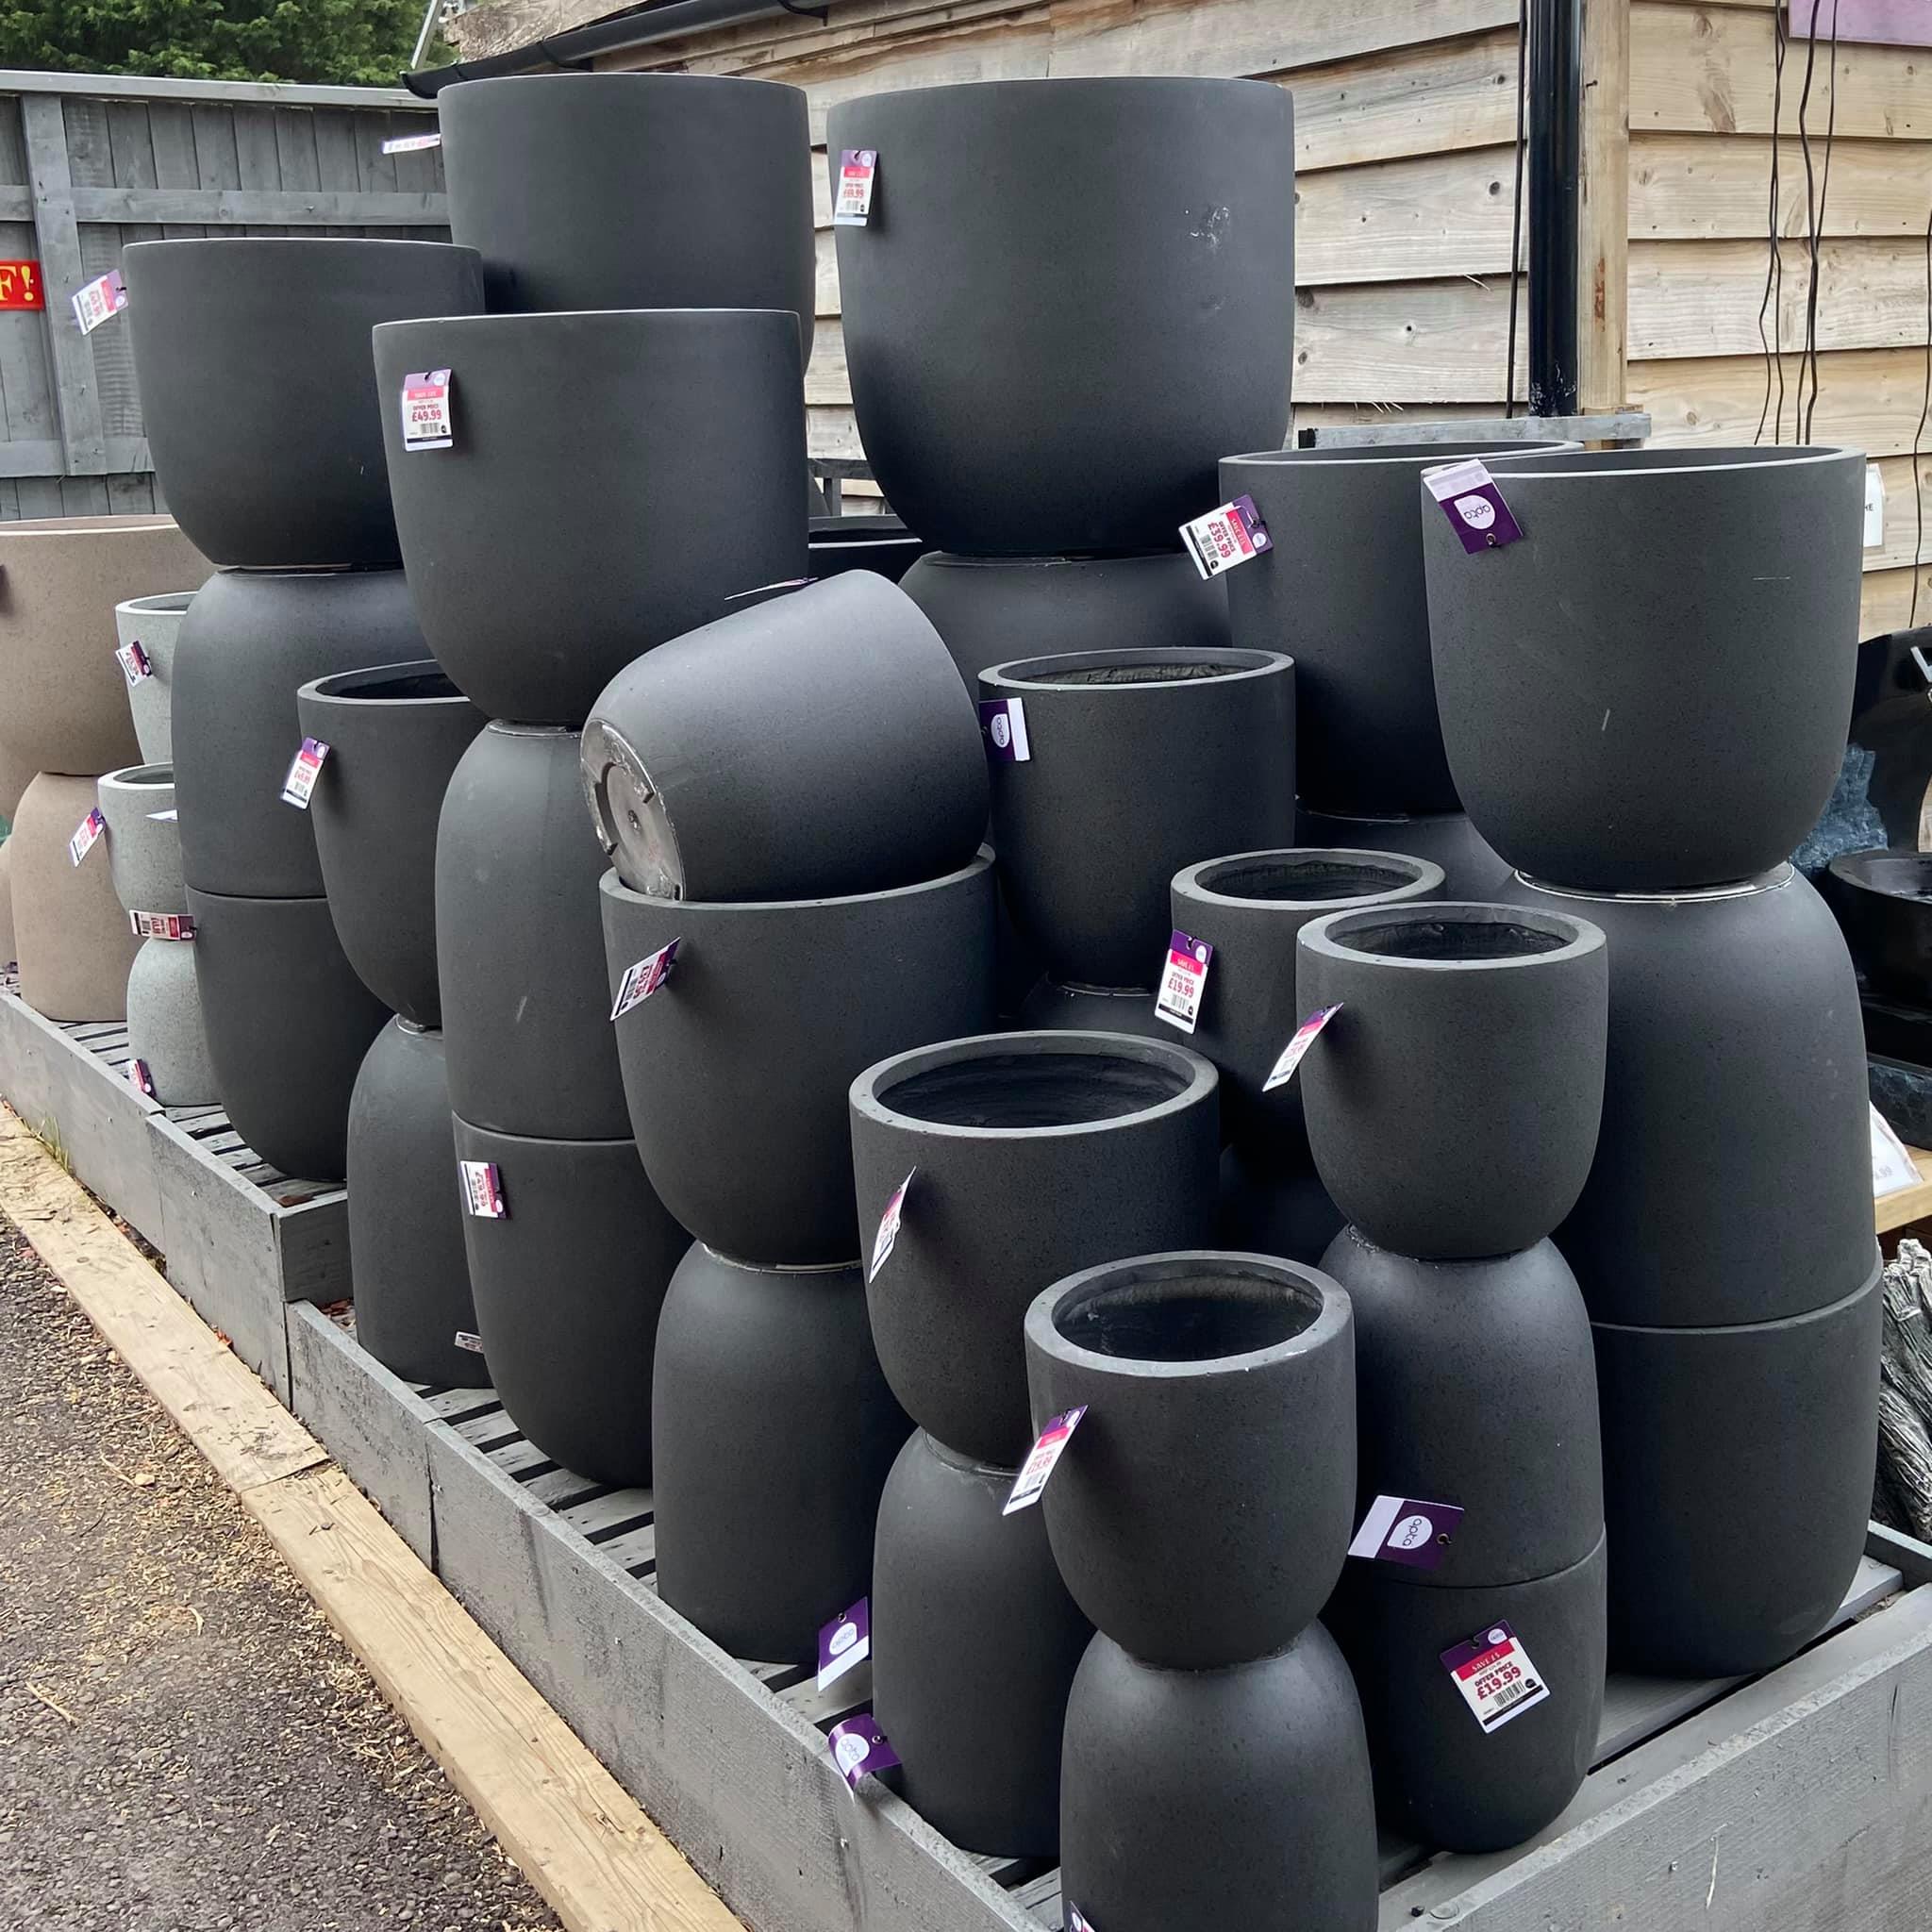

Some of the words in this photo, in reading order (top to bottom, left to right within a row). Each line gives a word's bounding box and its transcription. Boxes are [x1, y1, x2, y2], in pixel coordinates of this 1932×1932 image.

[412, 409, 441, 422] £49.99
[1208, 523, 1231, 558] £39.99
[1168, 978, 1194, 998] £19.99
[1402, 1518, 1423, 1546] apta
[1472, 1658, 1490, 1673] SAVE
[1474, 1672, 1495, 1687] OFFER
[1494, 1661, 1513, 1675] PRICE
[1477, 1666, 1521, 1700] £19.99
